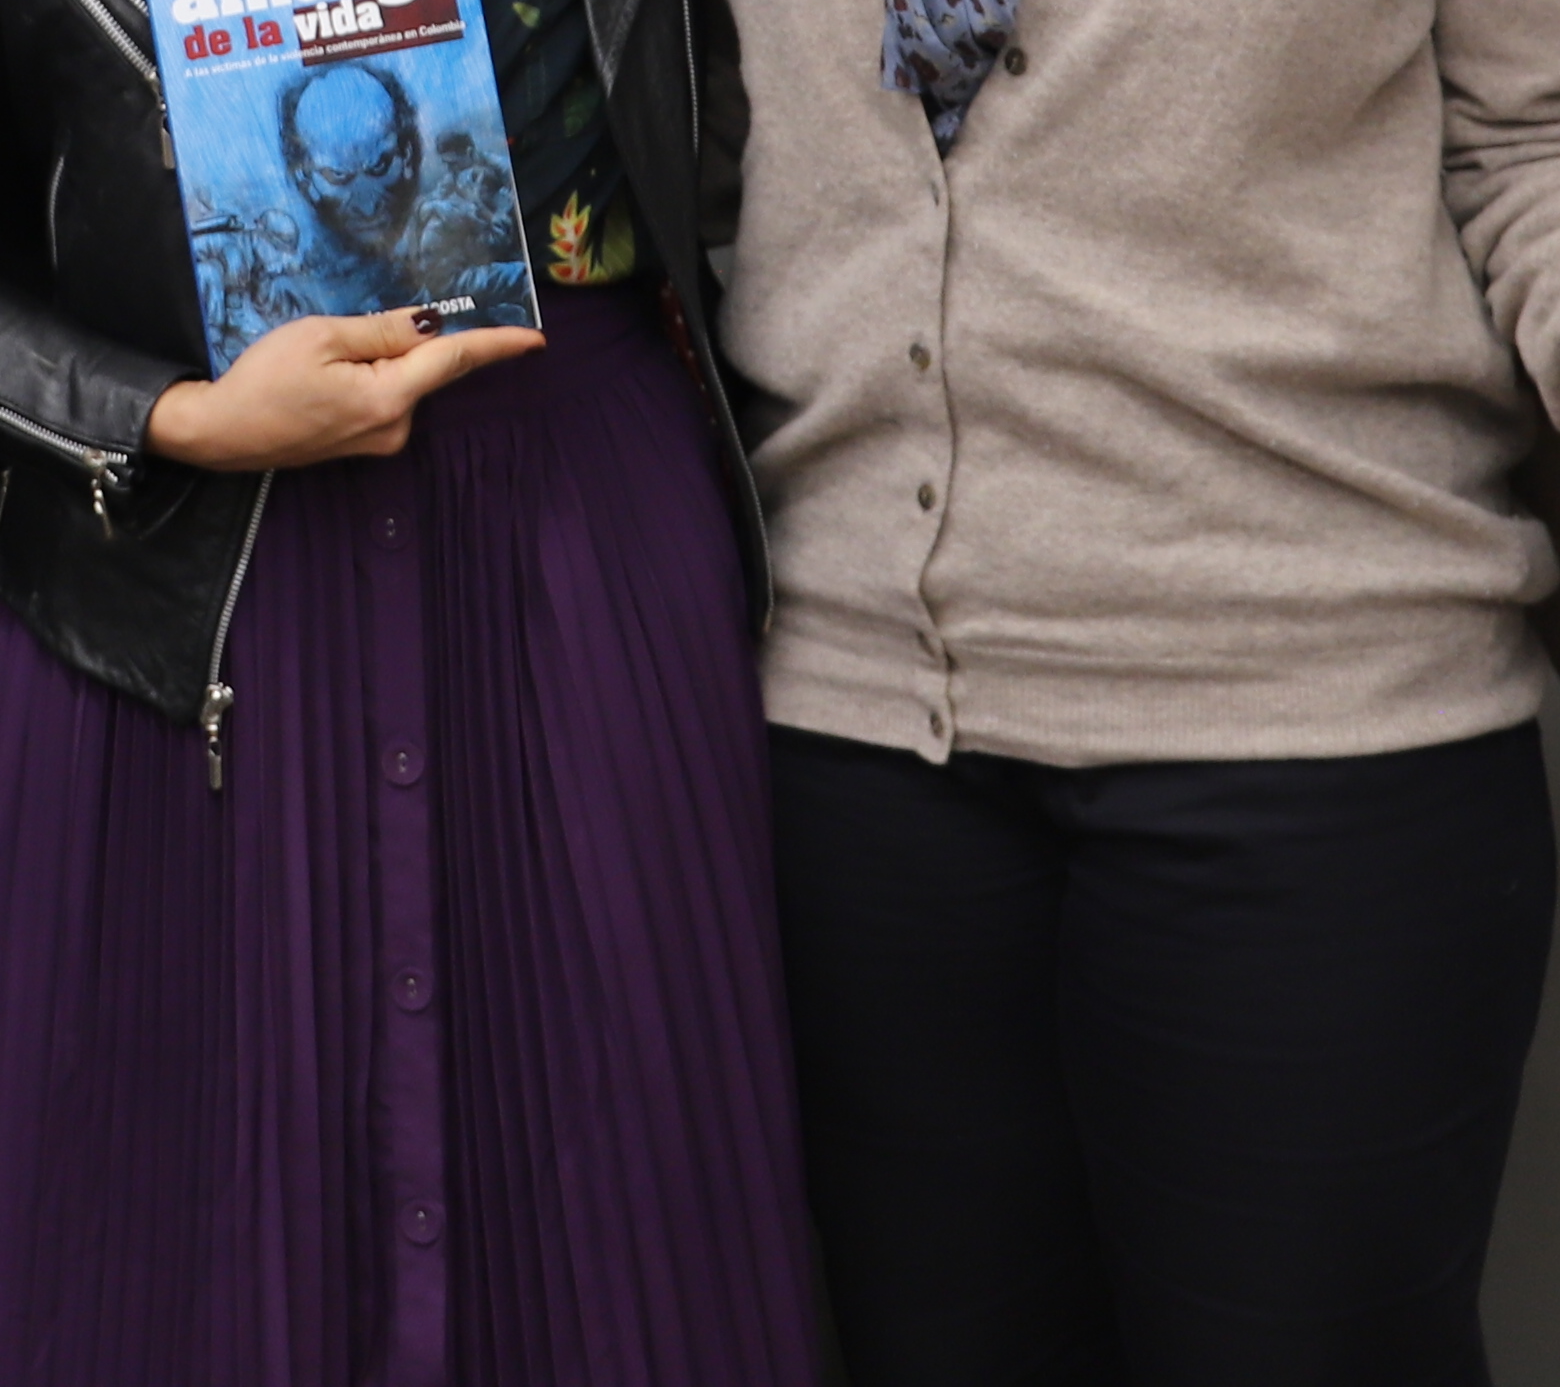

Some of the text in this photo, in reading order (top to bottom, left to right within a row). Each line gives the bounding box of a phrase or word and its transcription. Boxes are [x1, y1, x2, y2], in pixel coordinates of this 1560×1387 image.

[184, 25, 232, 61] de
[242, 16, 284, 49] la
[281, 45, 324, 62] violencia
[404, 29, 418, 40] en
[419, 20, 466, 37] Colombia
